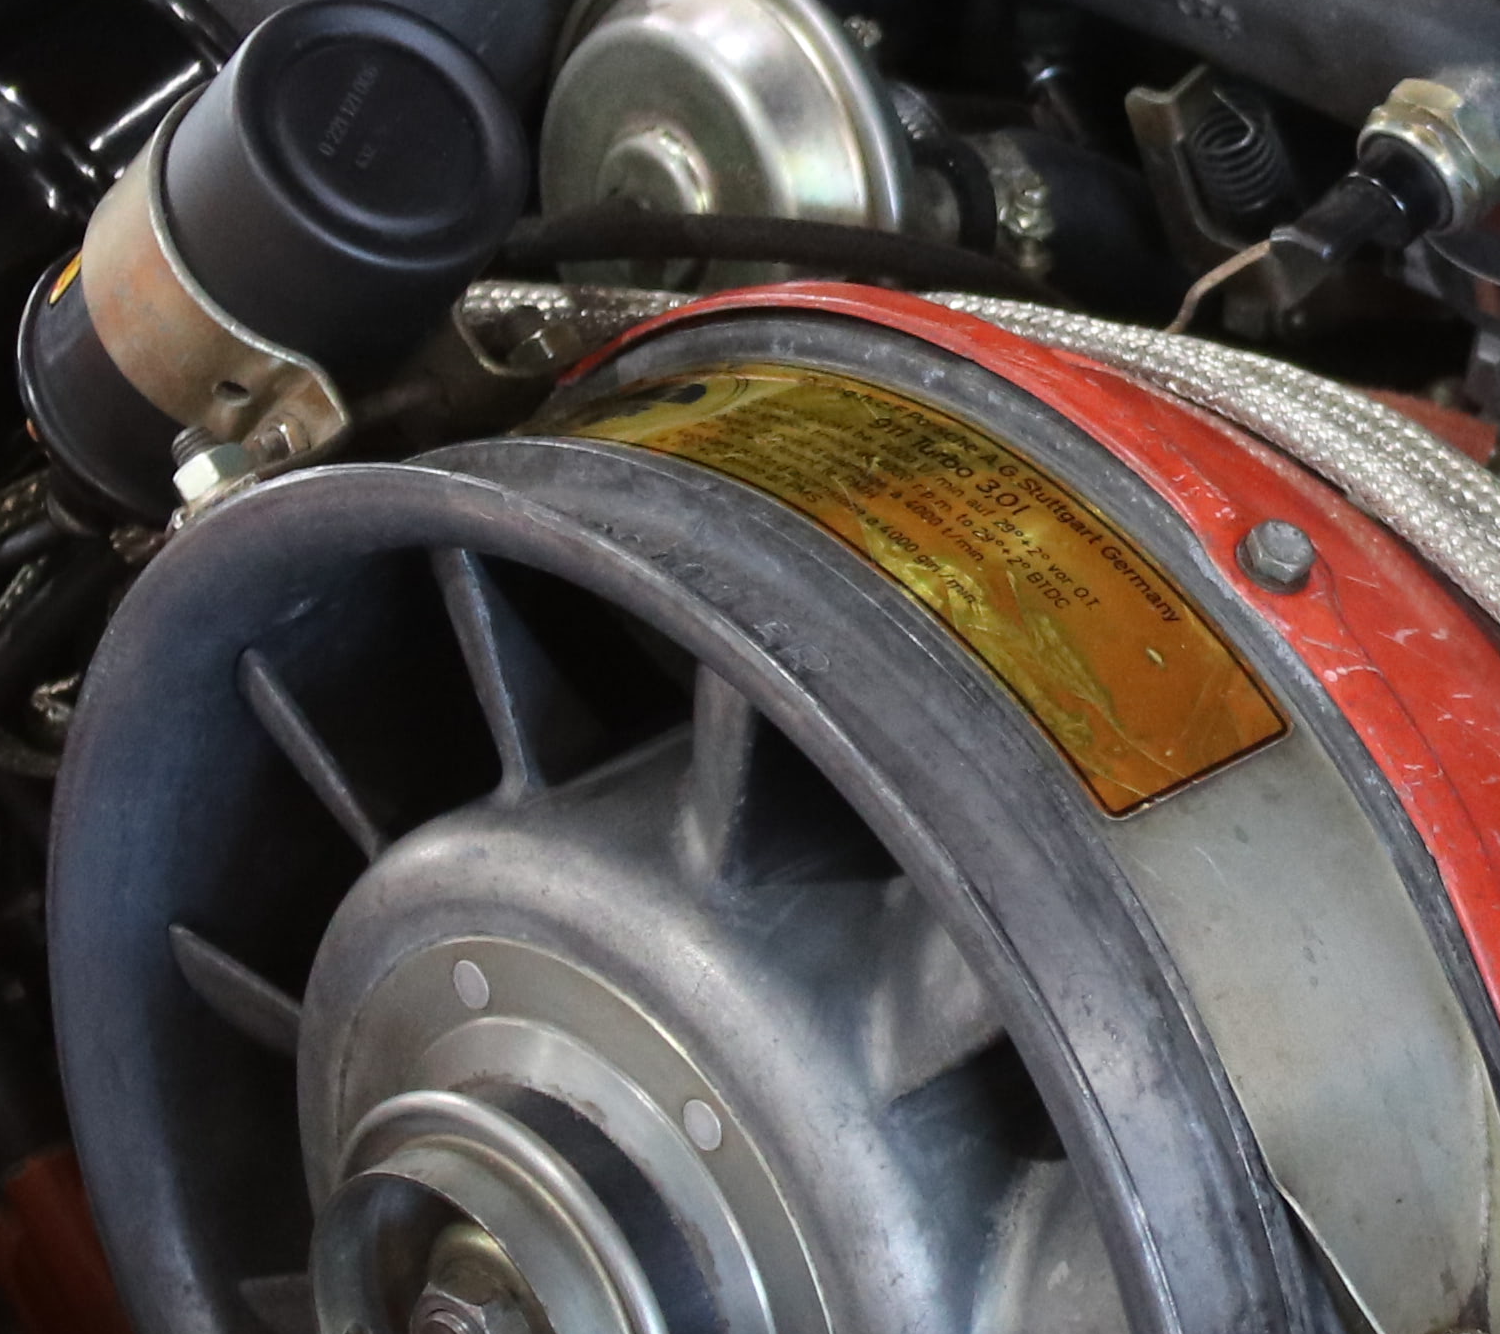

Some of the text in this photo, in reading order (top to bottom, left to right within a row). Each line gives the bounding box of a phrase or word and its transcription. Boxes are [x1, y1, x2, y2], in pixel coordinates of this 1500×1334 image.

[910, 435, 975, 479] Turbo
[1016, 478, 1104, 546] Stuttgart
[1100, 545, 1182, 623] Germany
[1026, 571, 1071, 610] BTDC
